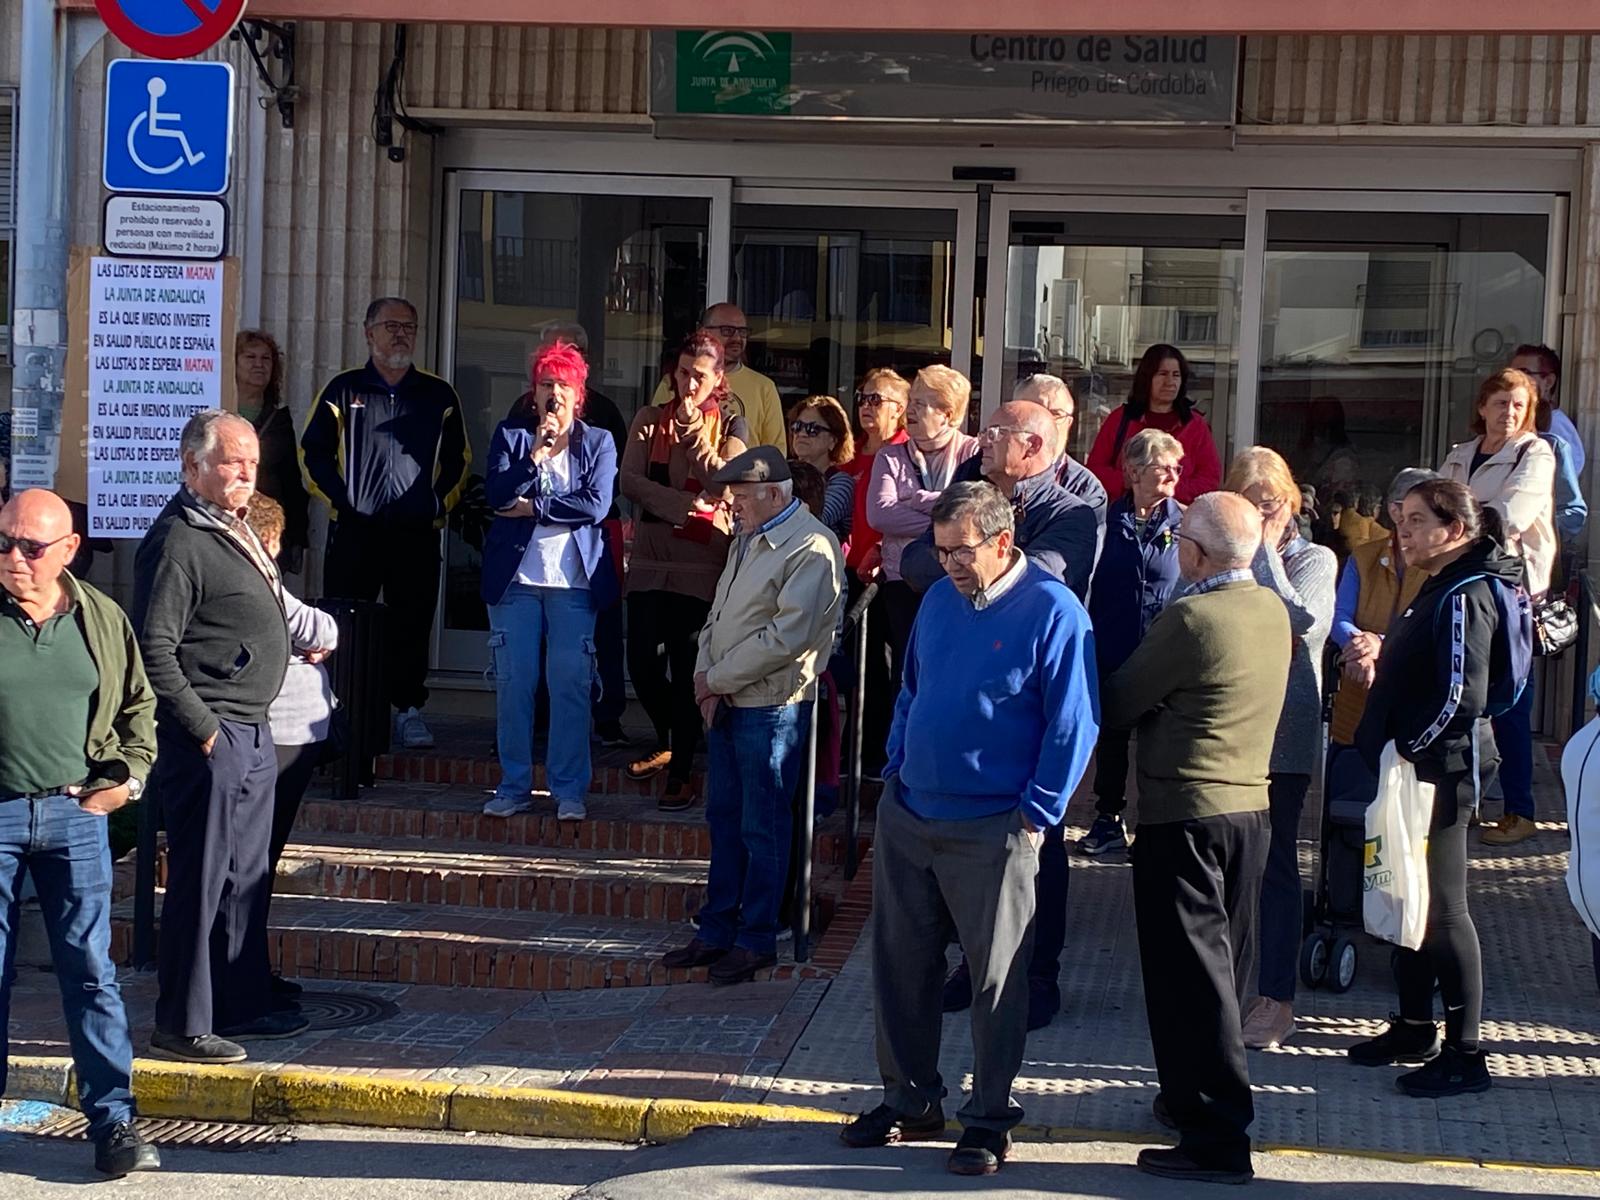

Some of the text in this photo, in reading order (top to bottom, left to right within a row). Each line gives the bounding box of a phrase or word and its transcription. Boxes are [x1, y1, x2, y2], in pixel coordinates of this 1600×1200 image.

[970, 35, 1207, 63] Centro de Salud
[690, 76, 716, 88] JUNTA
[720, 76, 730, 88] DE
[1032, 71, 1089, 97] Priego
[1097, 73, 1119, 93] de
[131, 201, 200, 213] Estacionamiento
[120, 215, 211, 227] prohibido reservado a
[116, 228, 214, 240] personas con movilidad
[110, 240, 220, 253] reducida (Máximo 2 horas)
[97, 263, 216, 280] LAS LISTAS DE ESPERA MATAN
[104, 285, 206, 304] LA JUNTA DE ANDALUCÍA
[98, 311, 211, 327] ES LA QUE MENOS INVIERTE
[93, 331, 216, 351] EN SALUD PÚBLICA DE ESPAÑA
[95, 356, 213, 372] LAS LISTAS DE ESPERA MATAN
[103, 377, 204, 395] LA JUNTA DE ANDALUCÍA
[98, 402, 107, 416] ES
[109, 403, 119, 416] LA
[121, 403, 139, 417] QUE
[141, 404, 170, 418] MENOS
[93, 425, 104, 439] EN
[106, 426, 132, 439] SALUD
[169, 427, 180, 440] DE
[94, 446, 180, 461] LAS LISTAS DE ESPERA
[103, 470, 182, 485] LA JUNTA DE ANDAL
[97, 493, 106, 507] ES
[108, 493, 119, 507] LA
[121, 493, 138, 507] QUE
[93, 516, 104, 530] EN
[106, 516, 131, 530] SALUD
